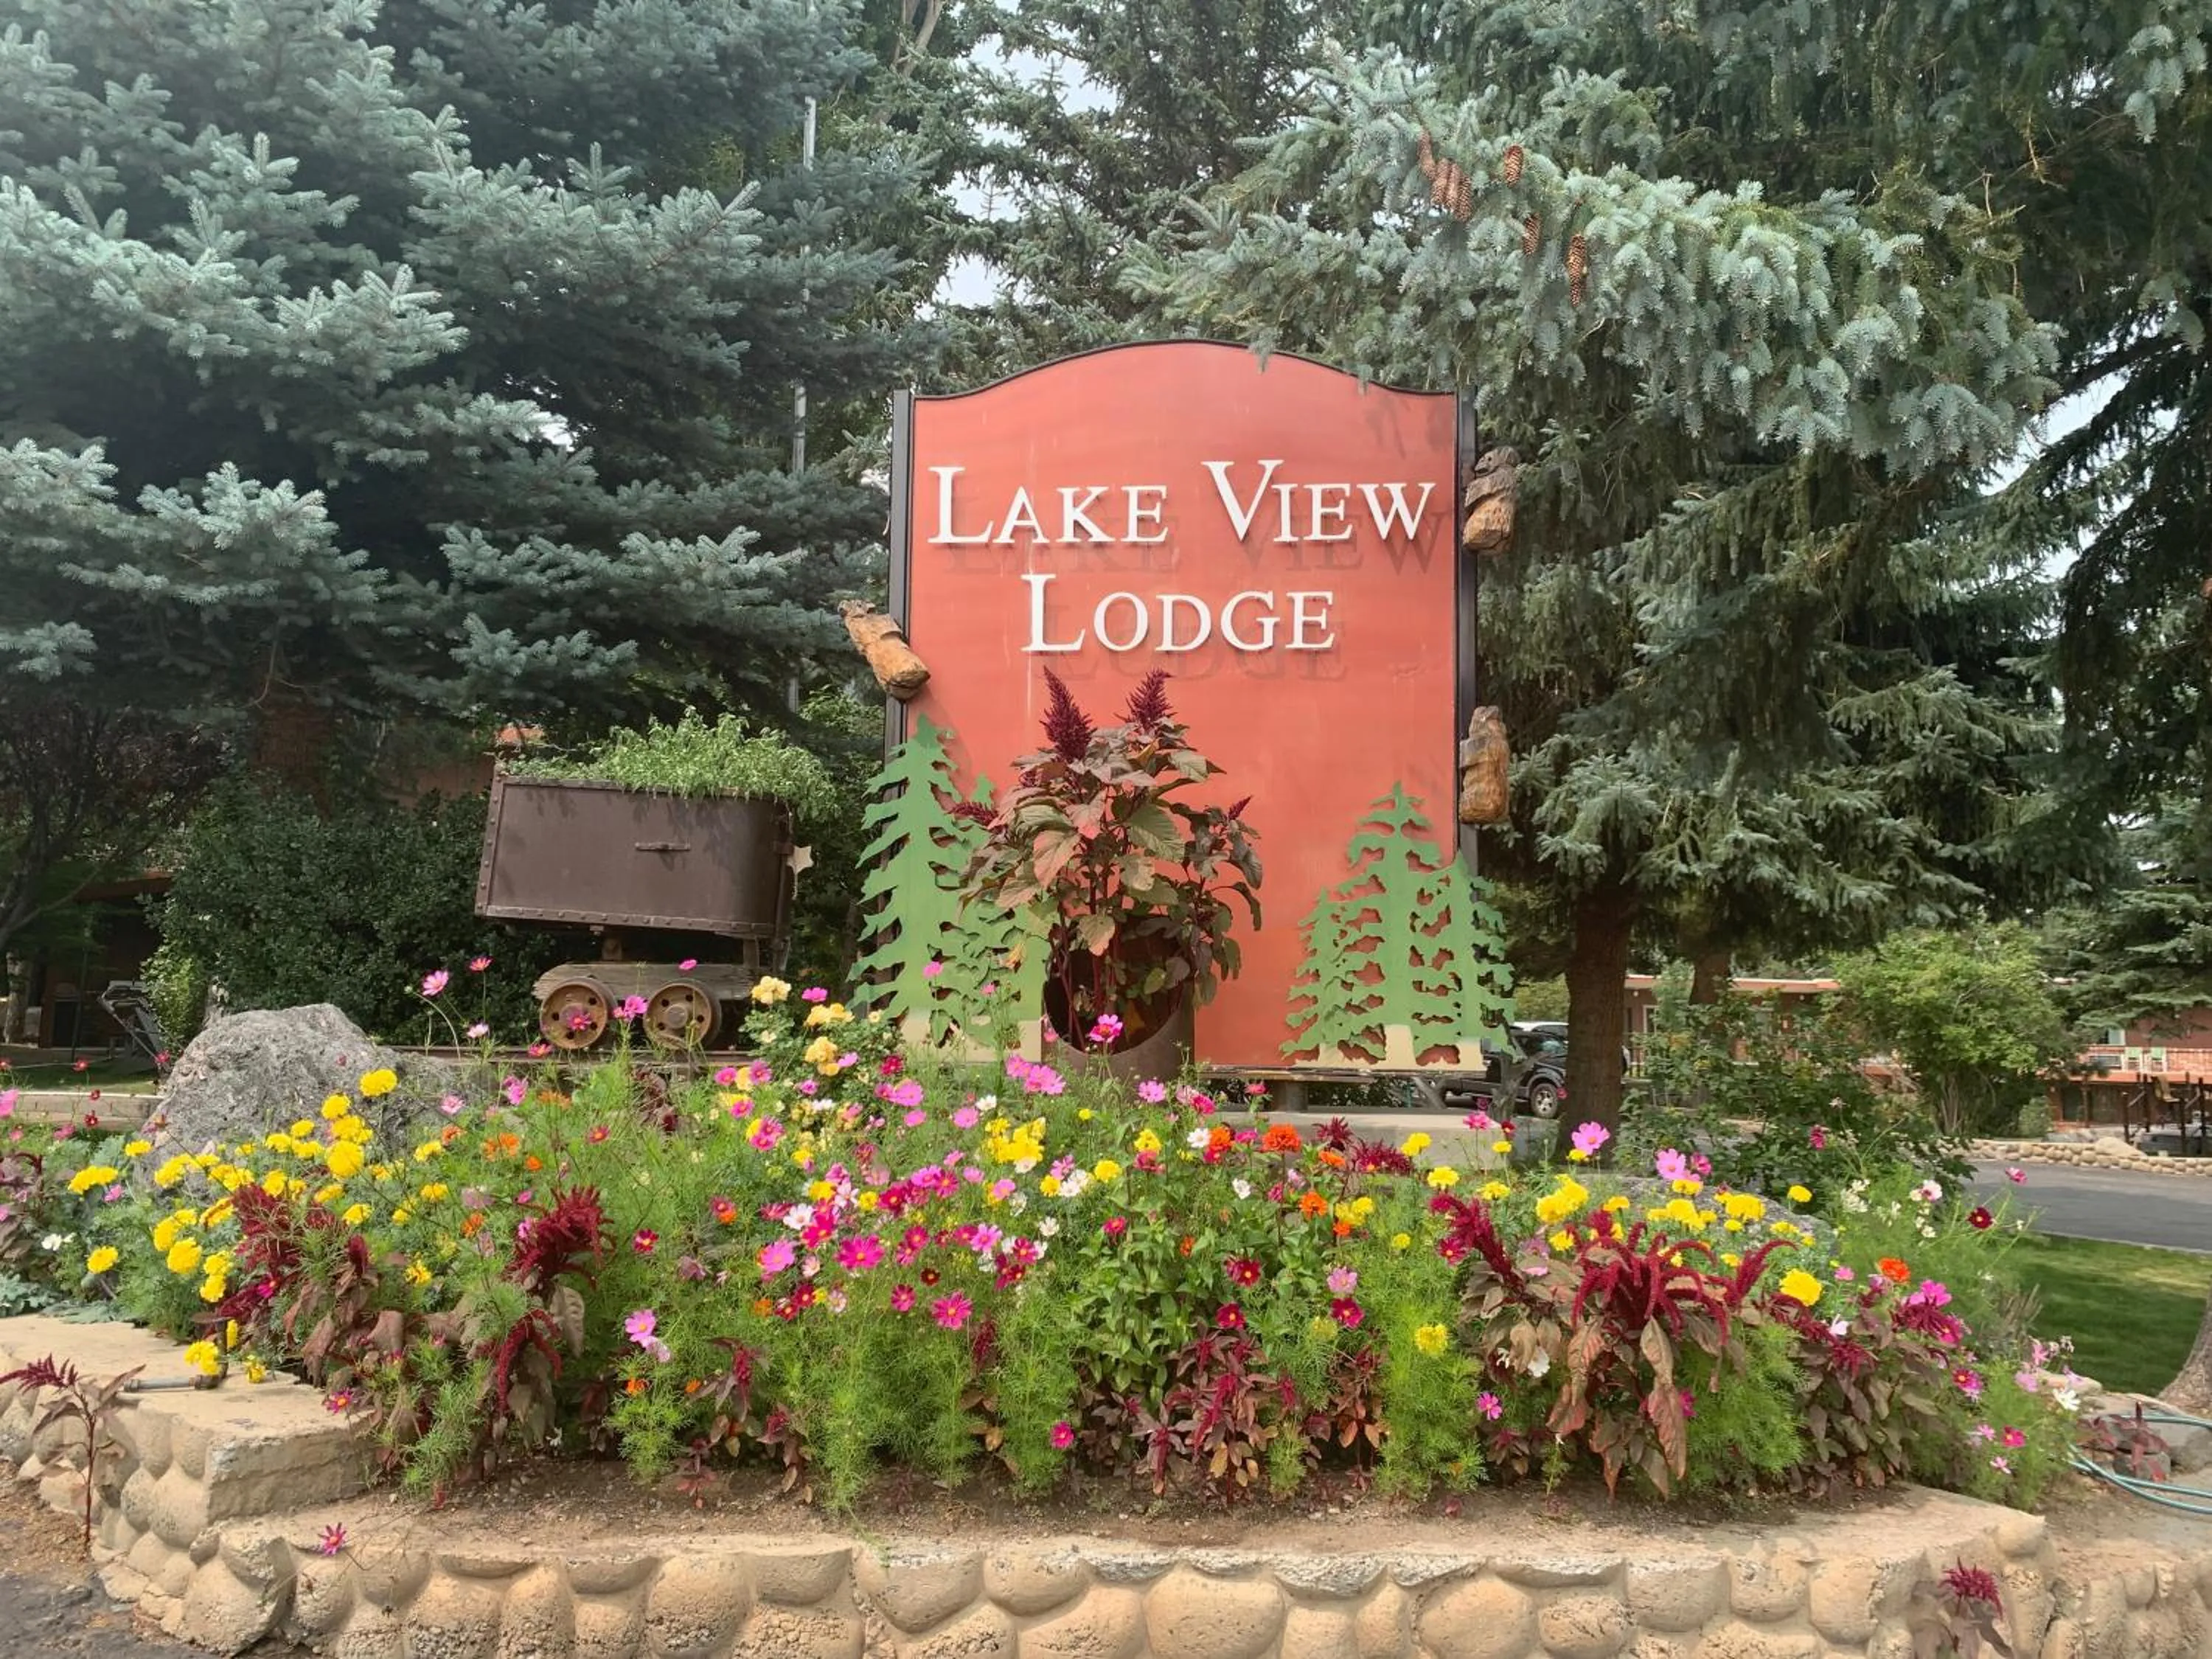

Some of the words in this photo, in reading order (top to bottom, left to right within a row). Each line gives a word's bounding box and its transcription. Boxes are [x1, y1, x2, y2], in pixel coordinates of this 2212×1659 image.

[928, 466, 1169, 543] LAKE
[1201, 459, 1436, 541] VIEW
[1021, 573, 1335, 653] LODGE
